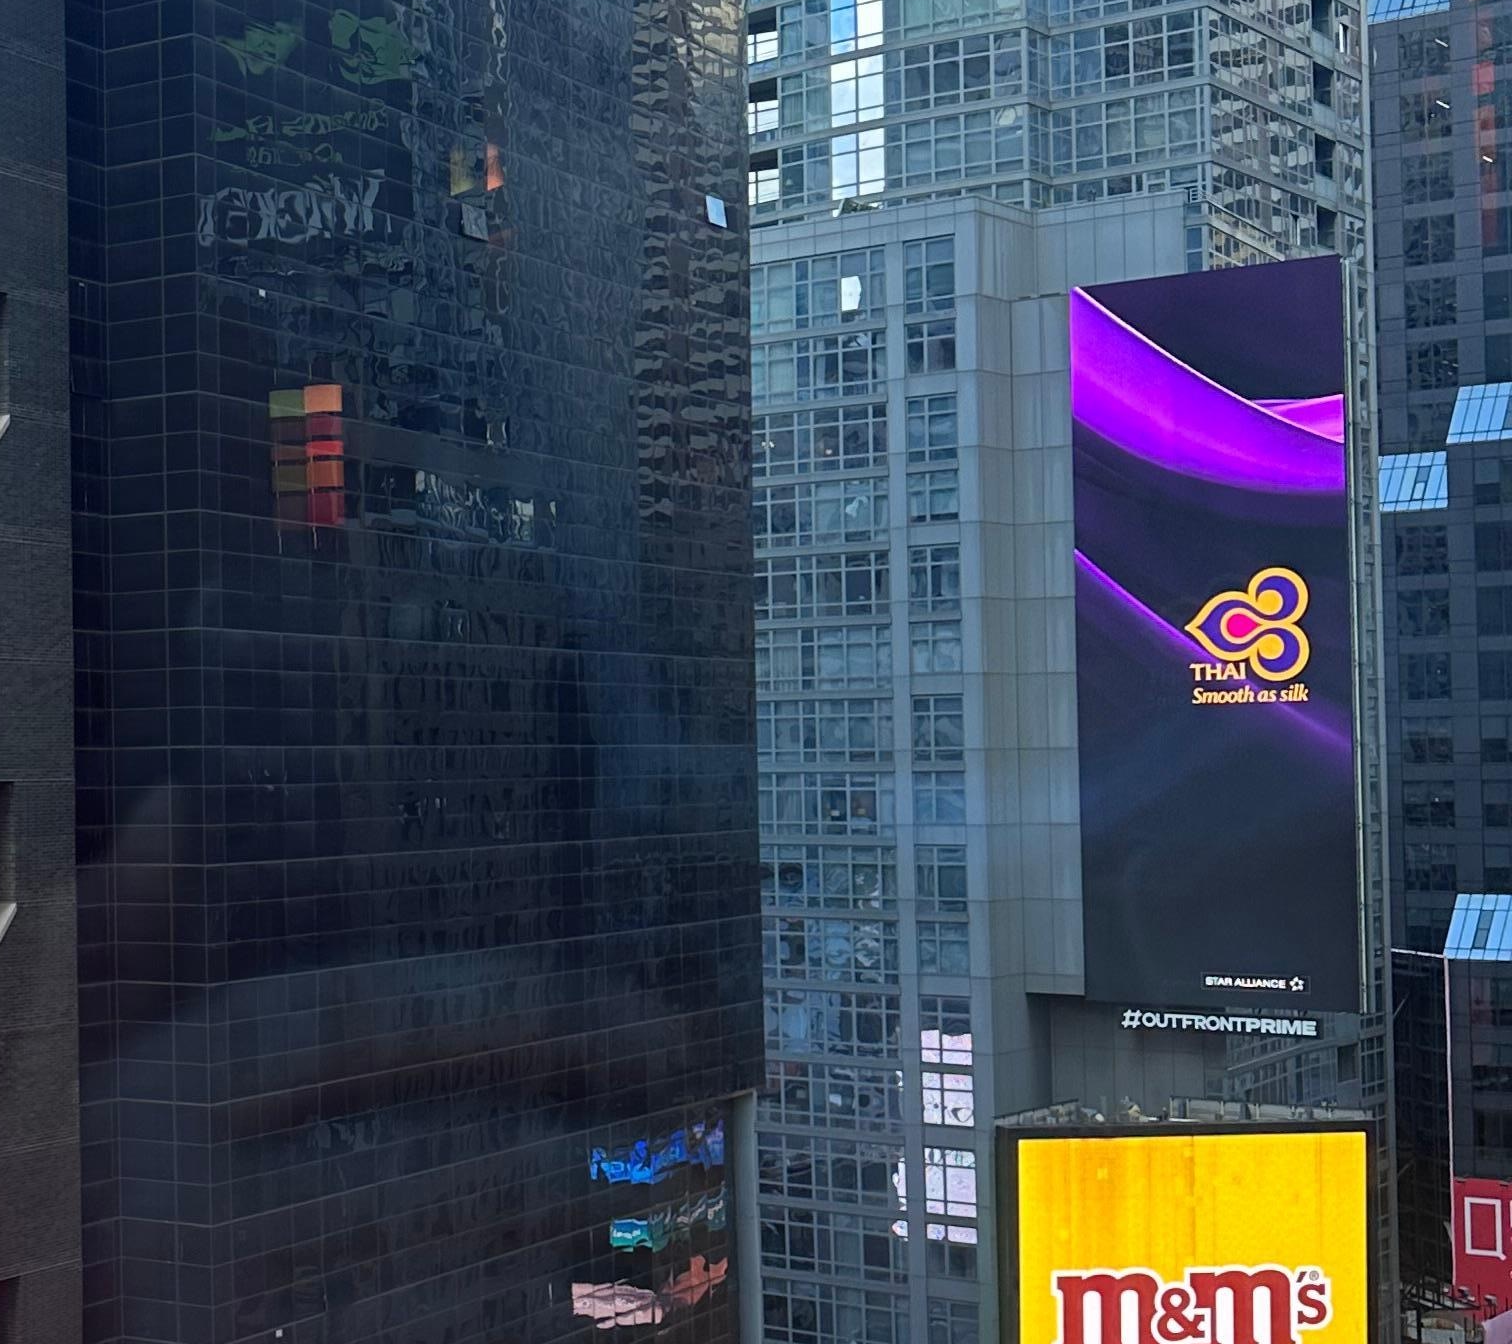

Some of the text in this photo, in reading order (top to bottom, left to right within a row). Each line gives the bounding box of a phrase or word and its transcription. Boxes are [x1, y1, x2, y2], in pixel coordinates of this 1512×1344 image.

[1189, 662, 1246, 682] THAI
[1191, 683, 1309, 706] Smooth as silk
[1205, 976, 1286, 990] STAR ALLIANCE
[1121, 1009, 1317, 1037] #OUTFRONTPRIME
